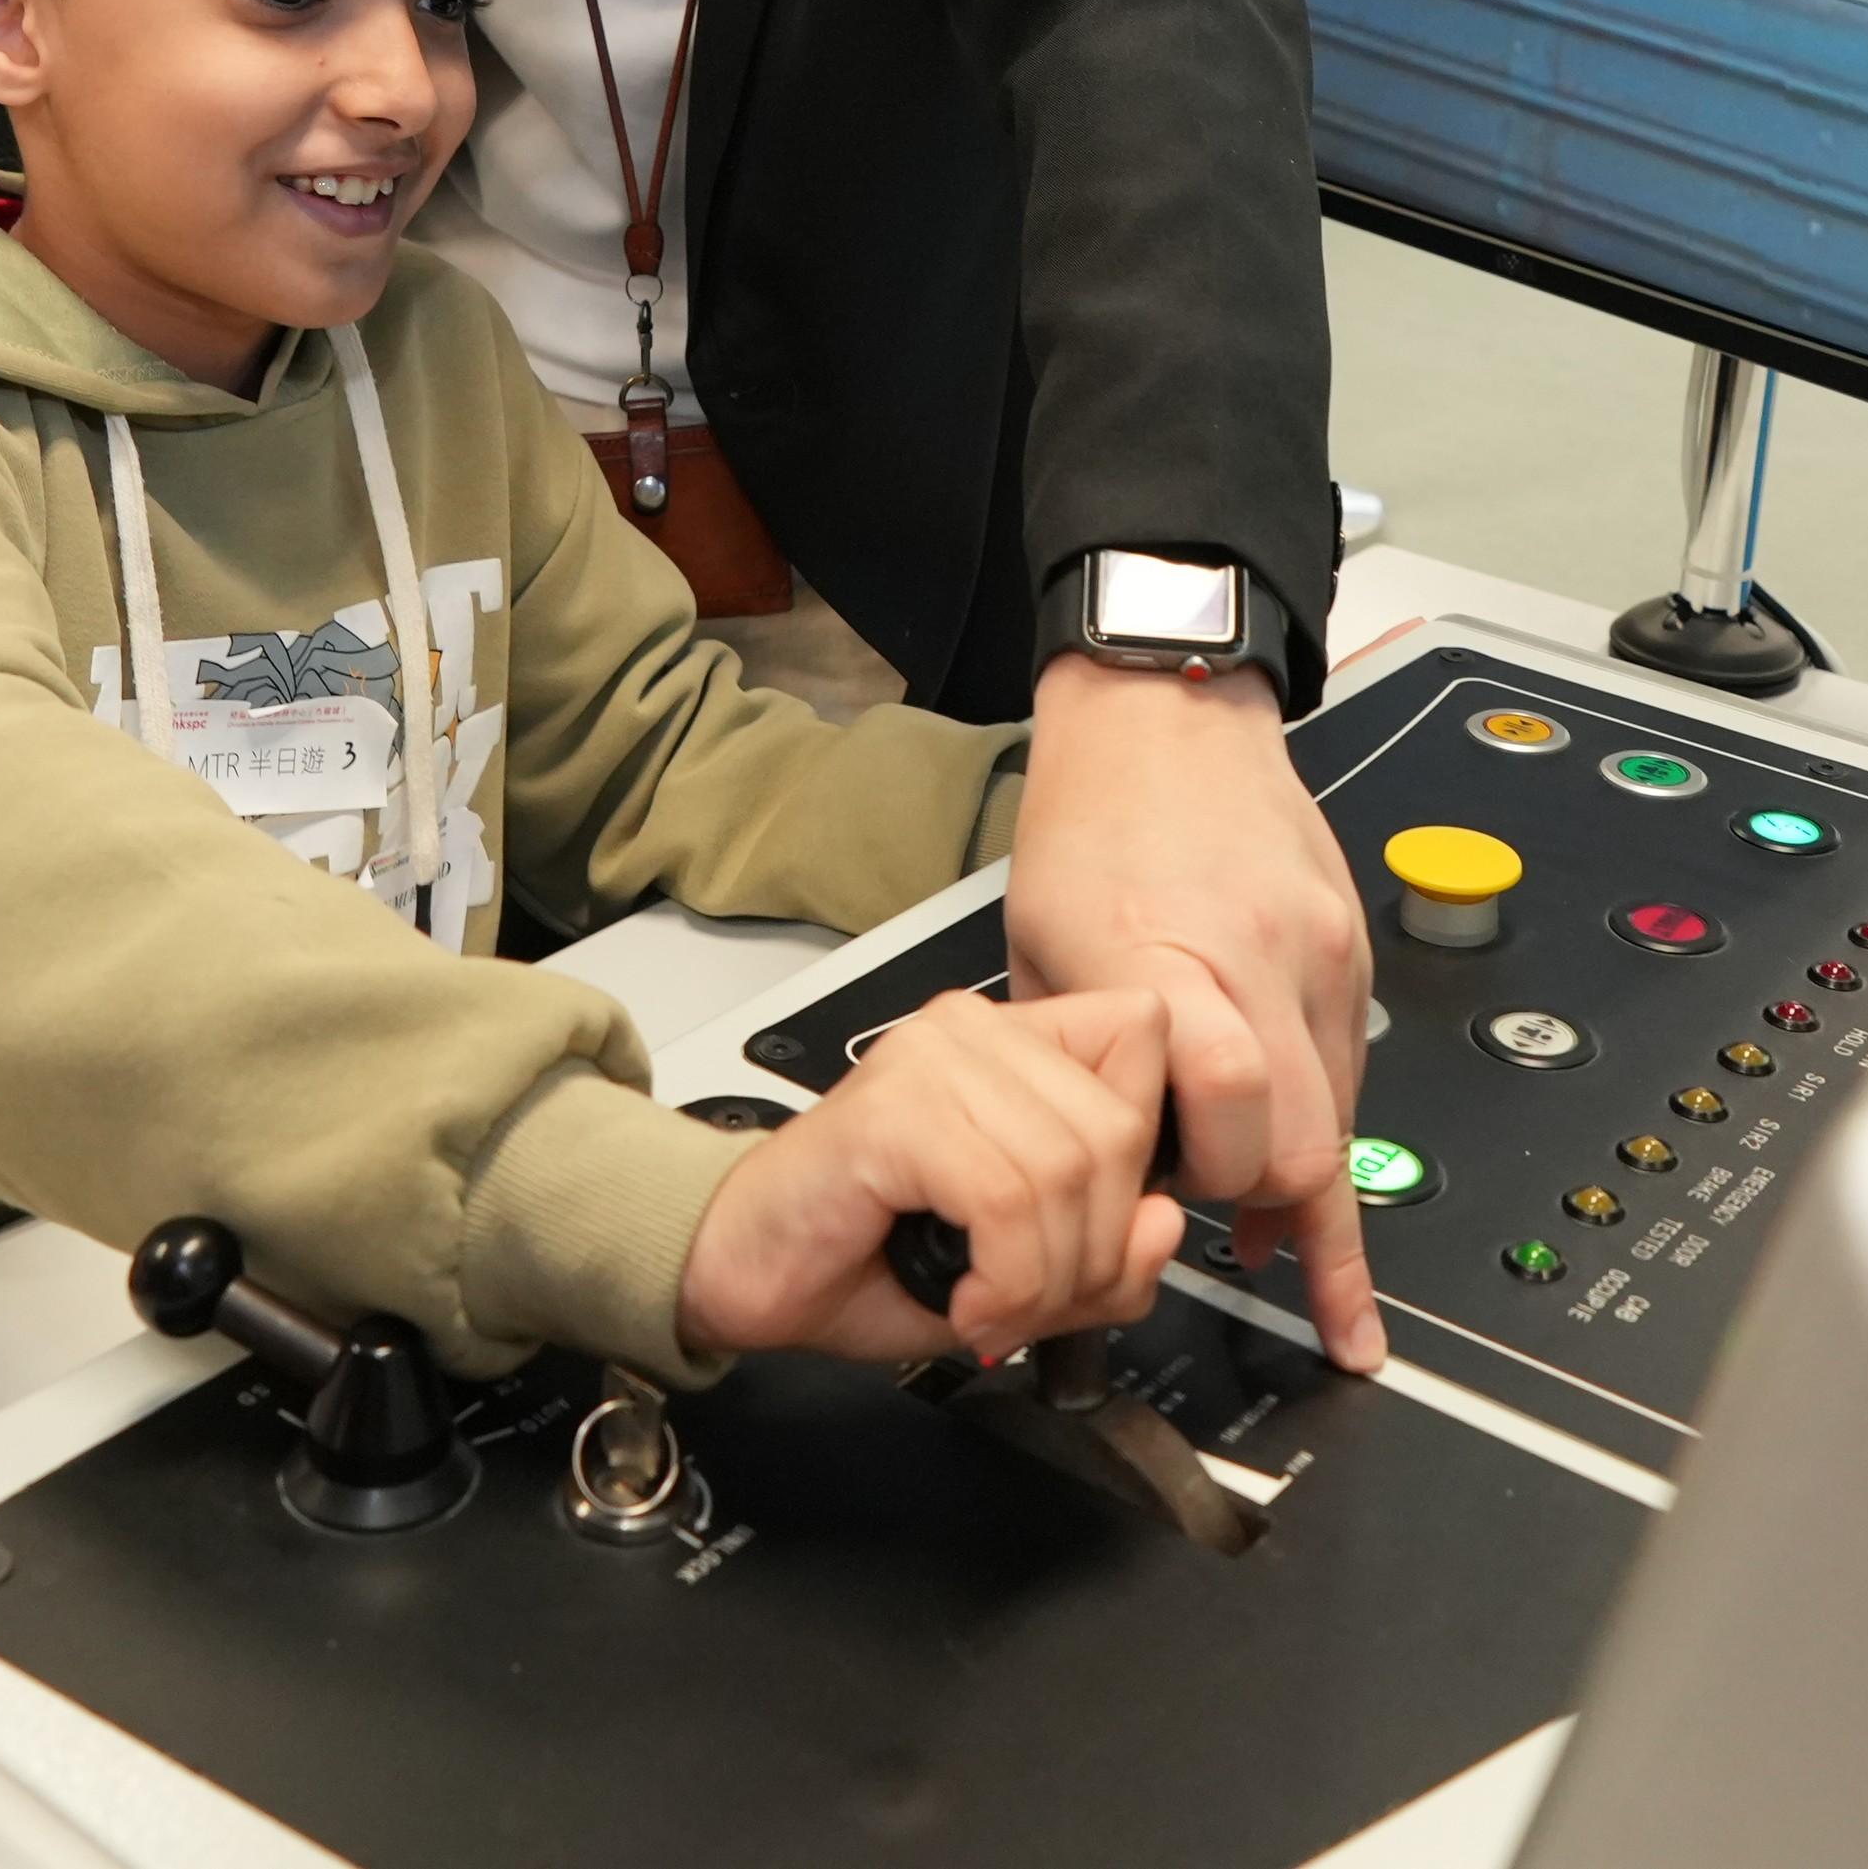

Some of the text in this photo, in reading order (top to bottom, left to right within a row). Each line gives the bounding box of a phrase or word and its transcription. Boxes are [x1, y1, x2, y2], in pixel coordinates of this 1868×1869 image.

[188, 741, 357, 780] MTR 半日遊 3
[1686, 1165, 1734, 1204] BRAKE
[1708, 1165, 1776, 1227] EMERGENCY
[1631, 1216, 1685, 1262] TESTED
[1668, 1233, 1711, 1268] DOOR
[1613, 1294, 1651, 1324] CAB
